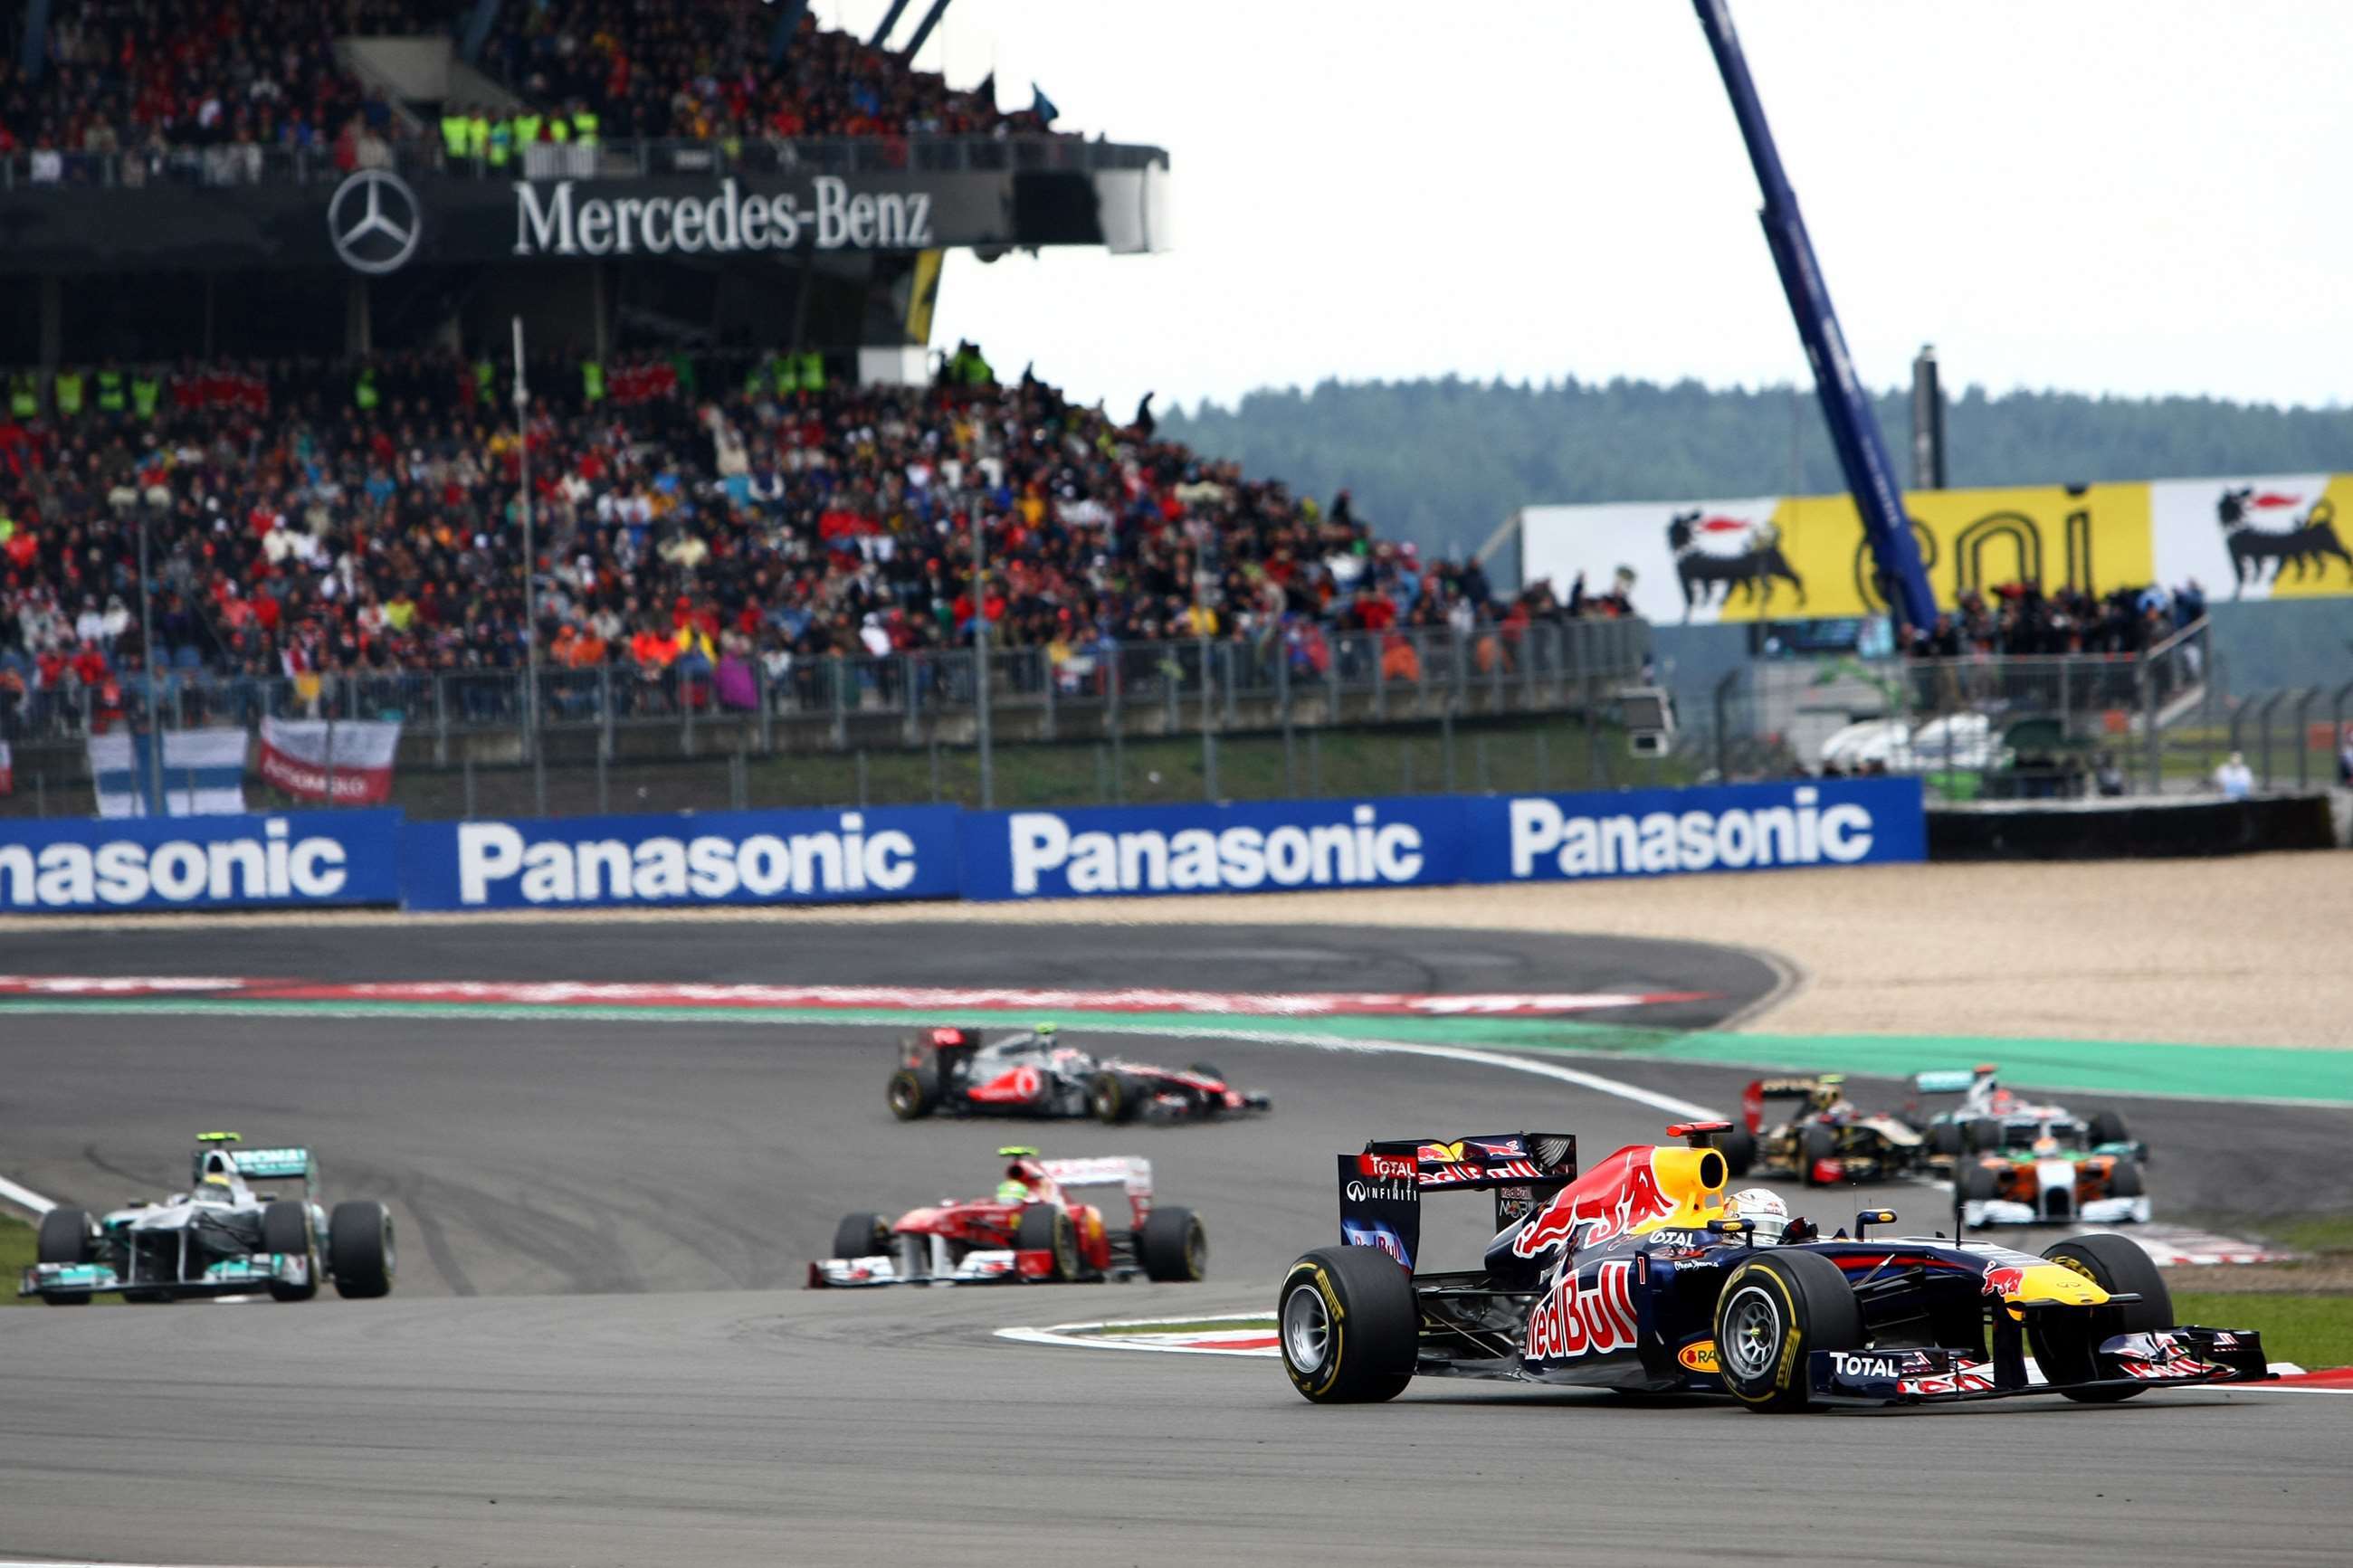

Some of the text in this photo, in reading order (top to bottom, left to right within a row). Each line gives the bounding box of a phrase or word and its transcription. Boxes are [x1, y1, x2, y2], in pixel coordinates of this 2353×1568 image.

[512, 176, 933, 255] Mercedes-Benz
[0, 819, 347, 905] nasonic
[458, 812, 916, 905] Panasonic
[1009, 804, 1424, 894] Panasonic
[1510, 786, 1874, 879] Panasonic
[1367, 1186, 1417, 1202] INFINITI
[1370, 1155, 1416, 1177] TOTAL
[1829, 1352, 1901, 1378] TOTAL
